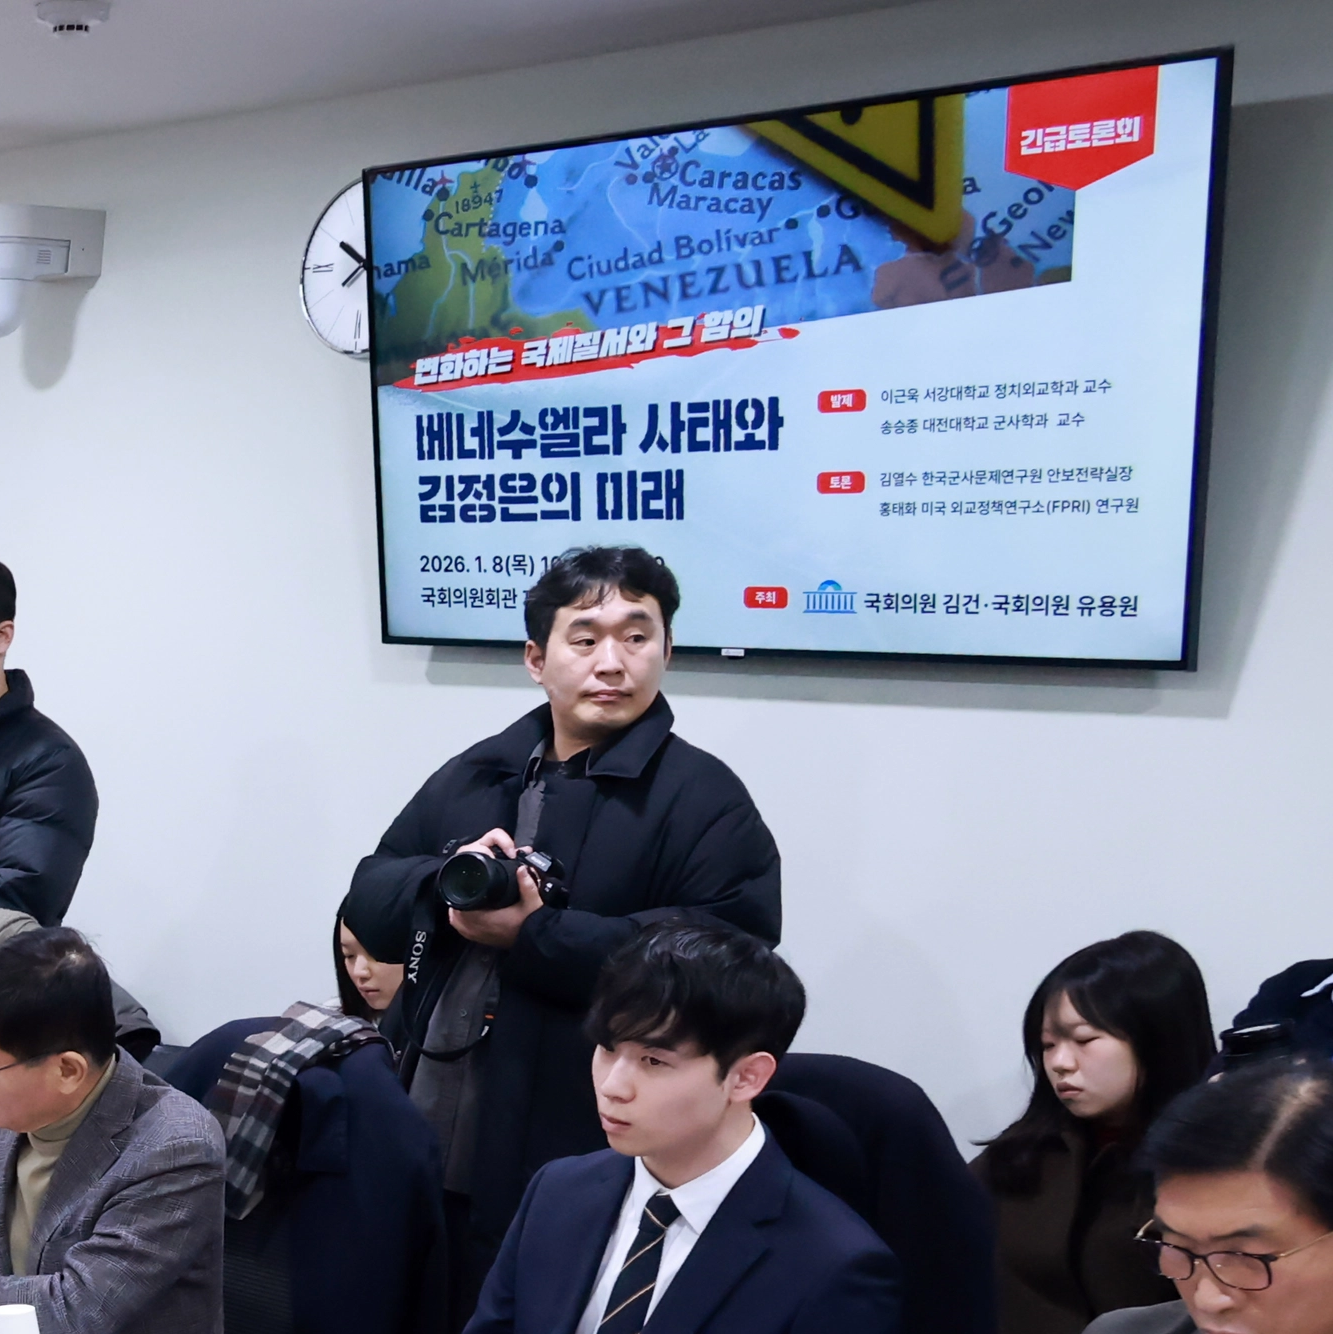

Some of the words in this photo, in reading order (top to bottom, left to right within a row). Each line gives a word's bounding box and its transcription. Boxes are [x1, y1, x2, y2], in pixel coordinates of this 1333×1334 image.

[1020, 116, 1141, 156] 긴급토론회
[679, 160, 803, 191] Caracas
[455, 189, 503, 214] 18947
[647, 183, 774, 222] Maracay
[434, 212, 566, 246] Cartagena
[461, 246, 555, 286] Mérida
[567, 242, 664, 281] Ciudad
[674, 225, 782, 260] Bolívar
[583, 244, 864, 316] VENEZUELA
[414, 347, 515, 386] 변화하는
[521, 321, 660, 367] 국제질서와
[662, 316, 696, 349] 그
[699, 304, 765, 343] 함의
[880, 387, 919, 404] 이근욱
[923, 384, 990, 402] 서강대학교
[993, 380, 1079, 399] 정치외교학과
[1082, 378, 1112, 394] 교수
[416, 404, 627, 461] 베네수엘라
[639, 397, 784, 454] 사태와
[880, 418, 918, 435] 송승종
[923, 416, 989, 433] 대전대학교
[993, 413, 1048, 430] 군사학과
[1056, 412, 1085, 428] 교수
[829, 475, 853, 490] 토론
[880, 472, 918, 487] 김열수
[921, 468, 1043, 487] 한국군사문제연구원
[1046, 465, 1133, 483] 안보전략실장
[418, 471, 581, 524] 김정은의
[597, 469, 685, 521] 미래
[879, 501, 917, 517] 홍태화
[921, 501, 946, 516] 미국
[950, 498, 1091, 516] 외교정책연구소(FPRI)
[1095, 498, 1139, 514] 연구원
[421, 587, 518, 609] 국회의원회관
[754, 591, 776, 605] 주최
[864, 592, 936, 614] 국회의원
[1076, 595, 1139, 618] 유용원
[407, 930, 427, 984] SONY
